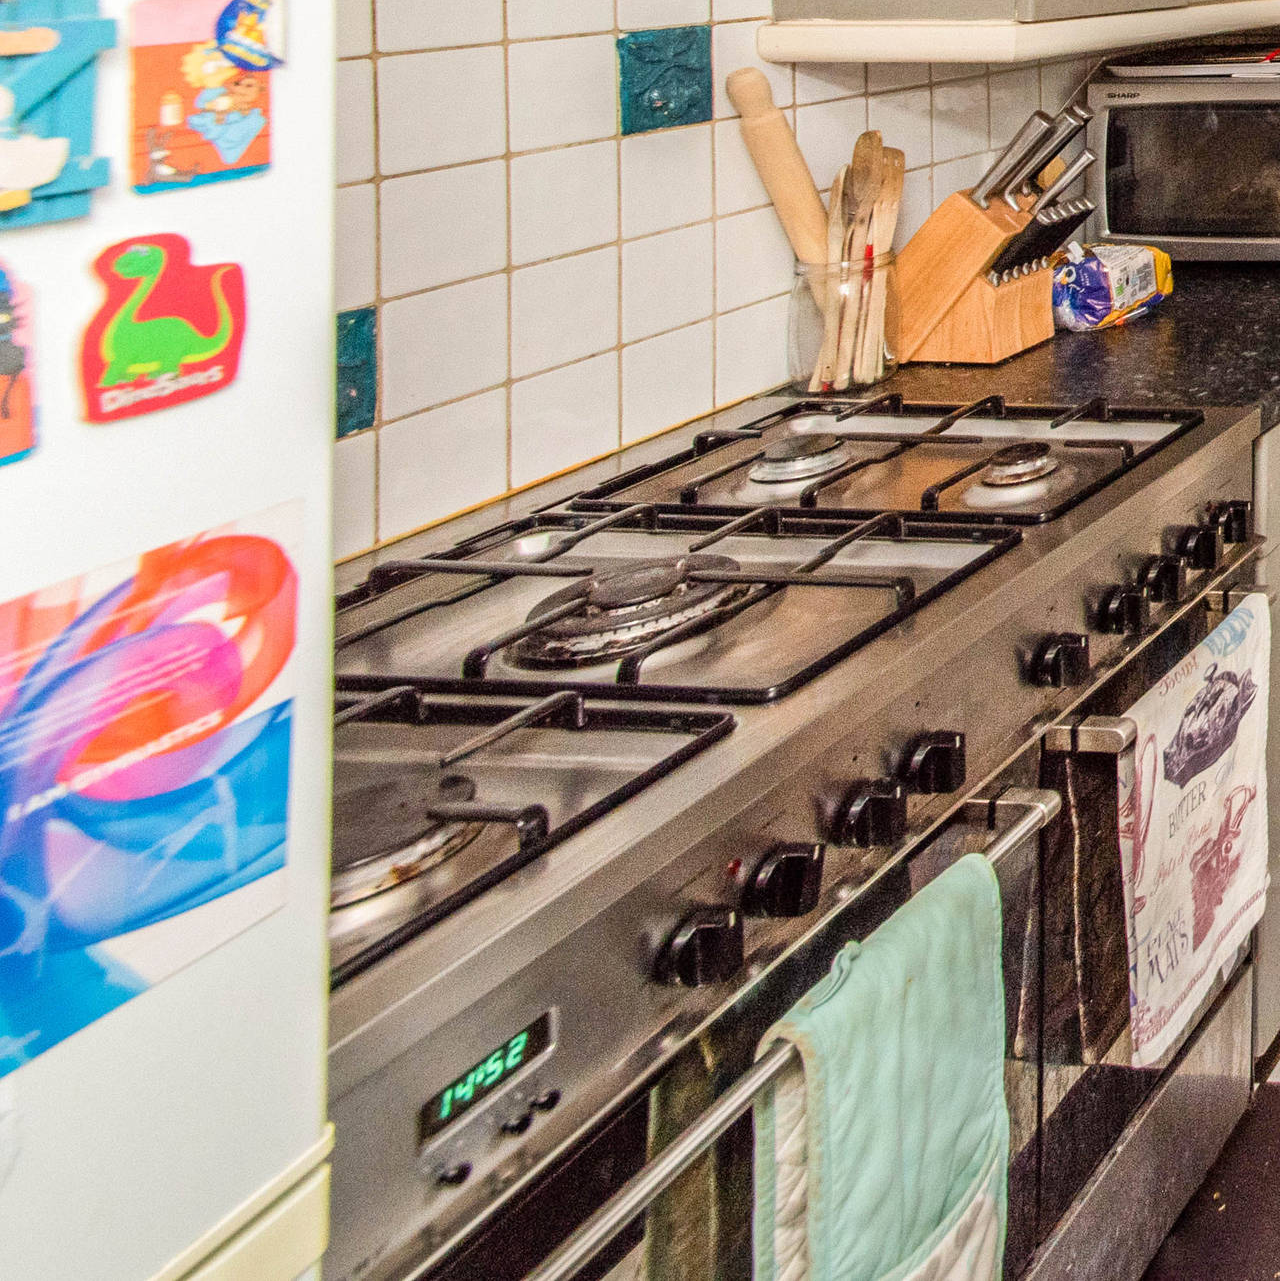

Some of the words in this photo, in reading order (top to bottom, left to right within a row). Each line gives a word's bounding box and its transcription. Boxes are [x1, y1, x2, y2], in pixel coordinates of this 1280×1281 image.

[67, 709, 225, 792] GYMNASTICS
[1168, 780, 1207, 839] BUTTER
[439, 1030, 529, 1119] 14:52
